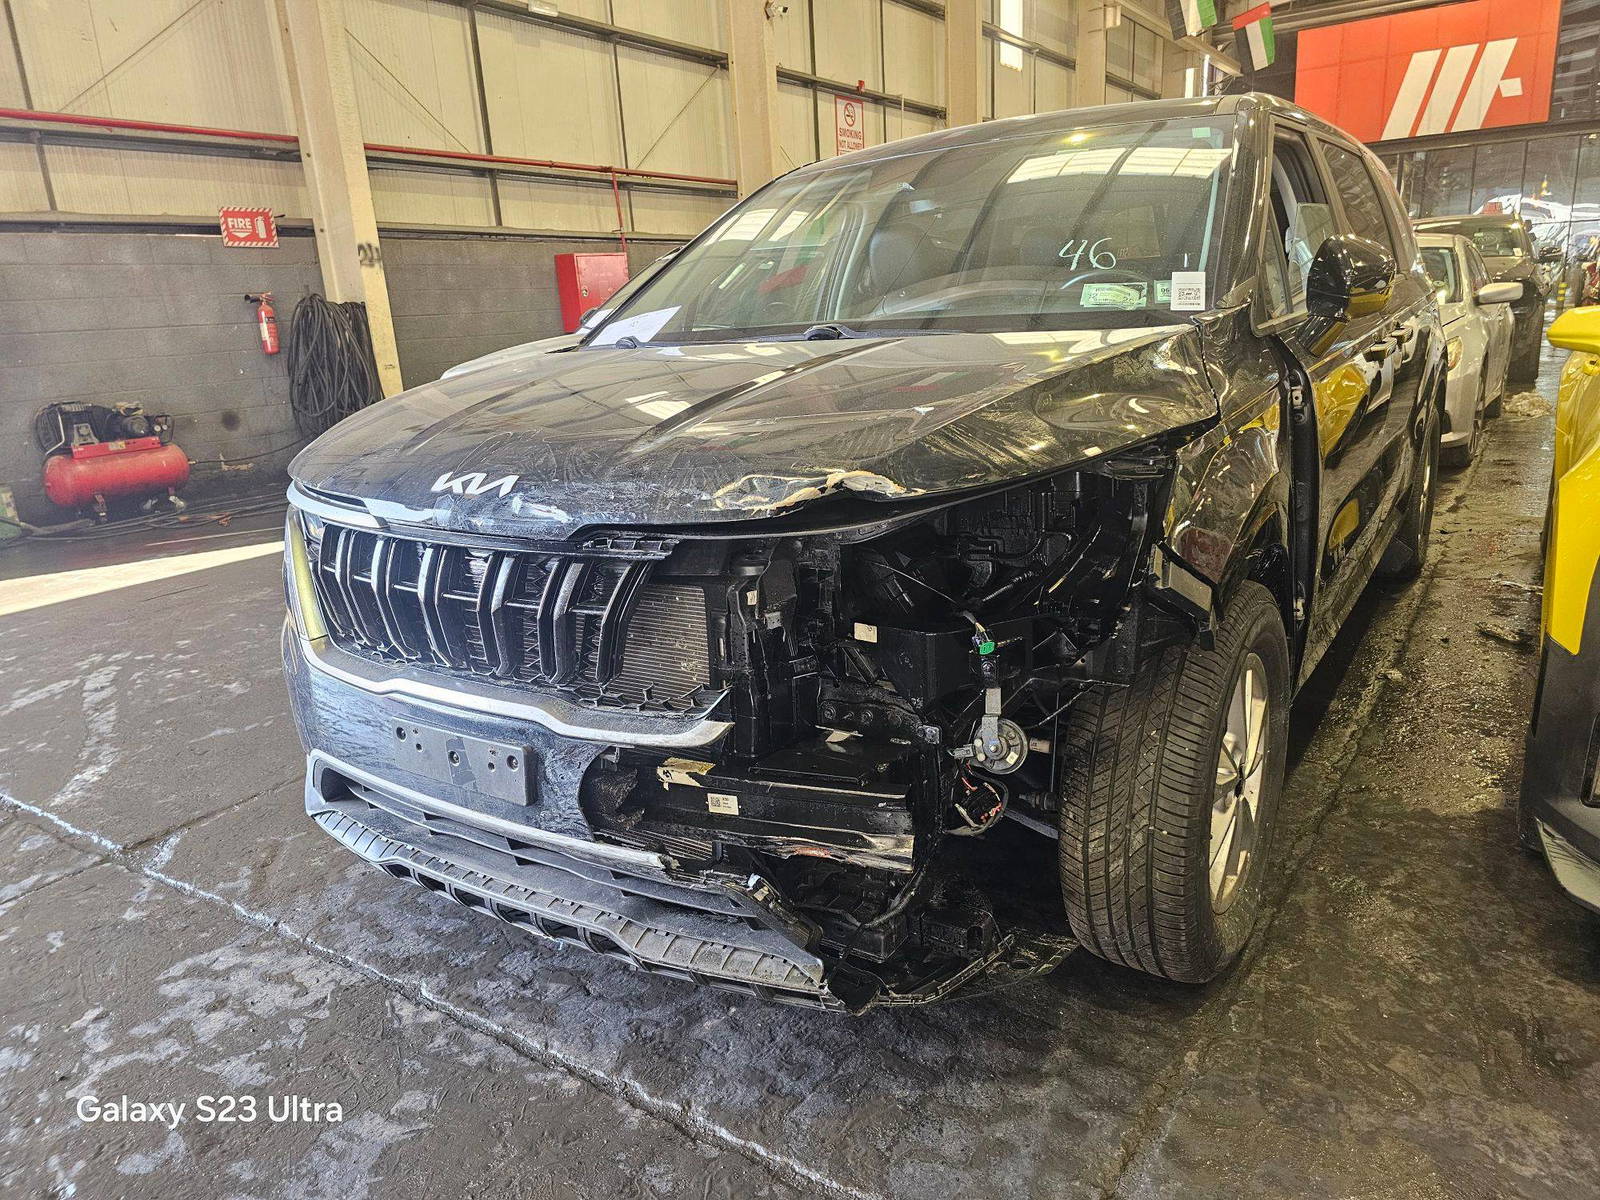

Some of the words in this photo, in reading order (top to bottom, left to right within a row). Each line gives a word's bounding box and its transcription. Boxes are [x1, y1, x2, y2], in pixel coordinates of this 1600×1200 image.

[839, 127, 862, 141] SMOKING
[839, 139, 847, 149] NOT
[227, 217, 253, 229] FIRE
[1058, 237, 1117, 271] 46
[430, 471, 520, 498] KIA
